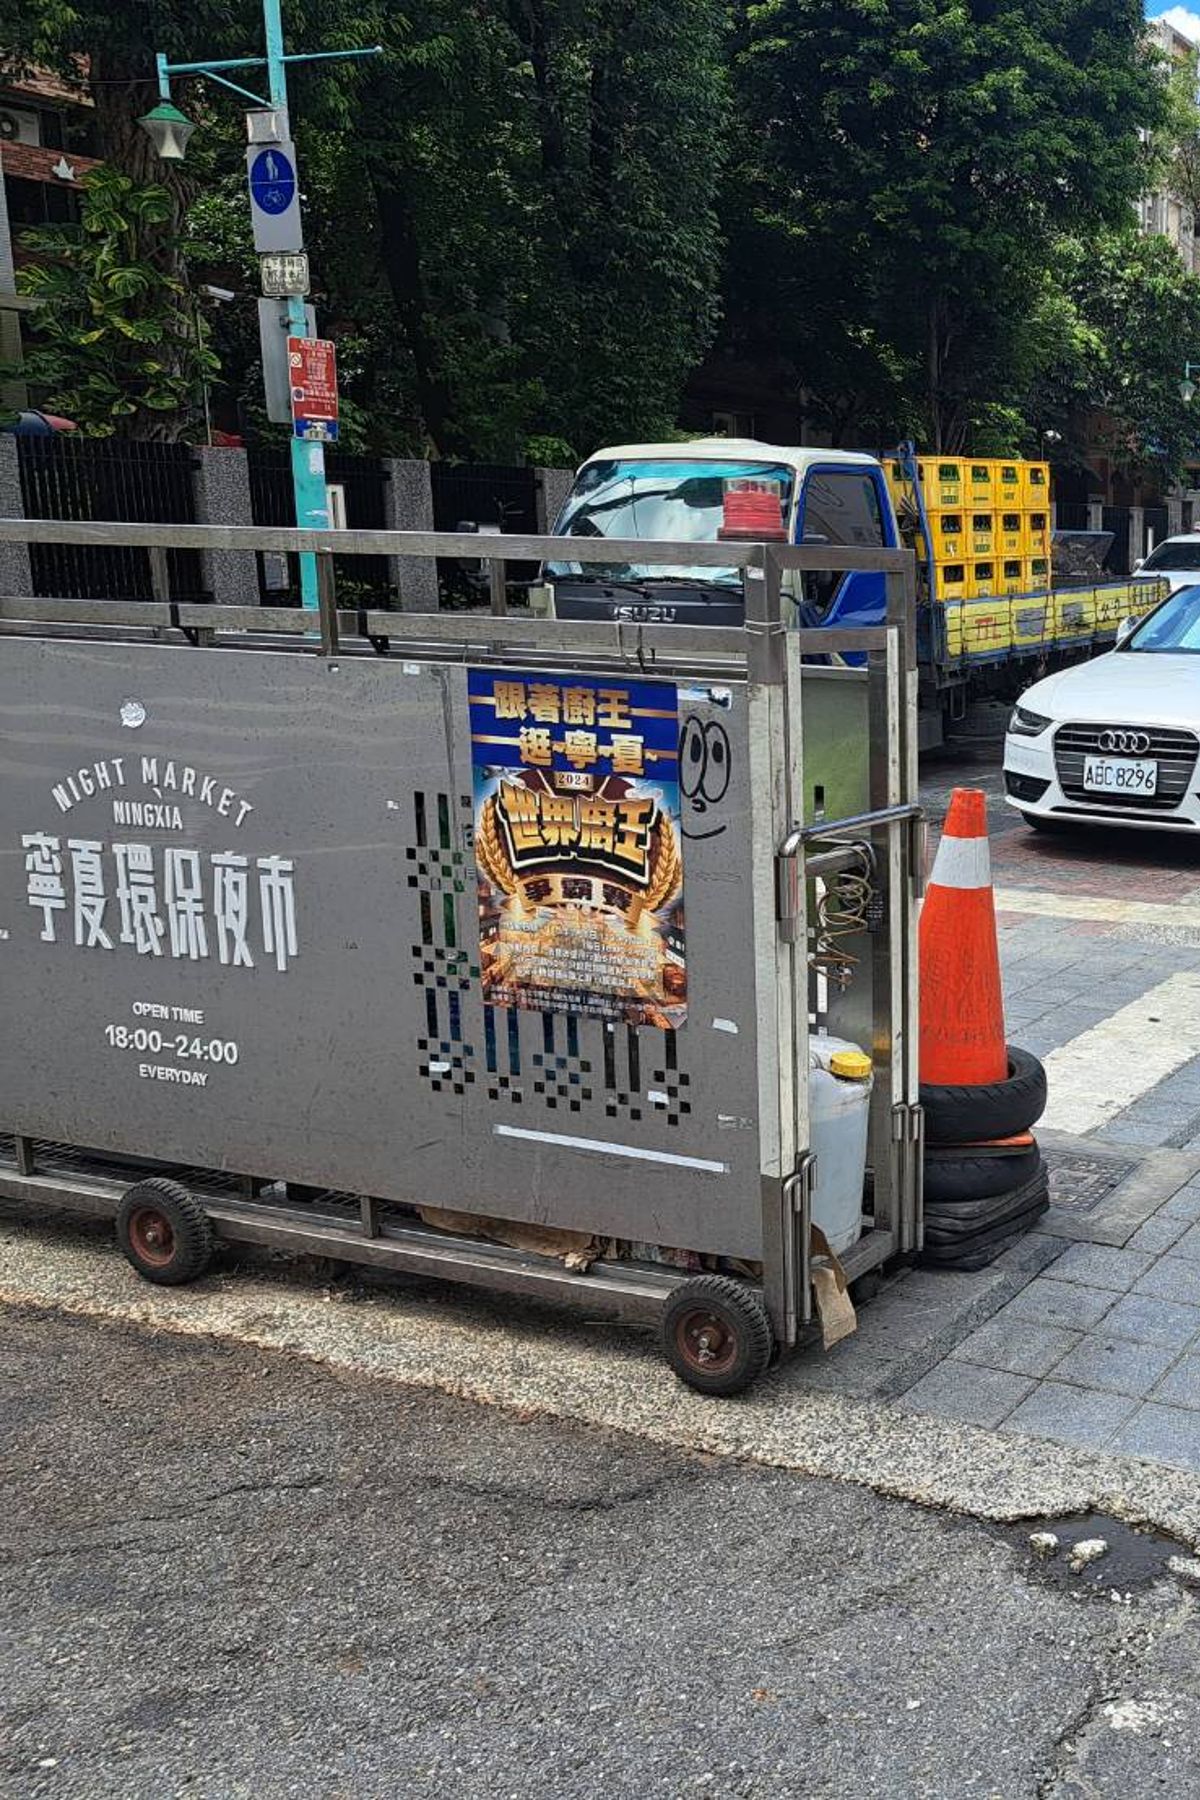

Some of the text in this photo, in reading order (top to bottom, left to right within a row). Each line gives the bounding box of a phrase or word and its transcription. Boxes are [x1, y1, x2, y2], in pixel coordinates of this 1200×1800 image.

[612, 606, 677, 622] ISUZU
[493, 680, 633, 728] 跟著廚王
[557, 774, 591, 786] 2024
[1116, 767, 1154, 789] 8296
[52, 757, 254, 827] NIGHT MARKET
[113, 801, 183, 830] NINGXIA
[21, 831, 299, 971] 寧夏環保夜市
[132, 1001, 204, 1025] OPEN TIME
[139, 1063, 209, 1086] EVERYDAY
